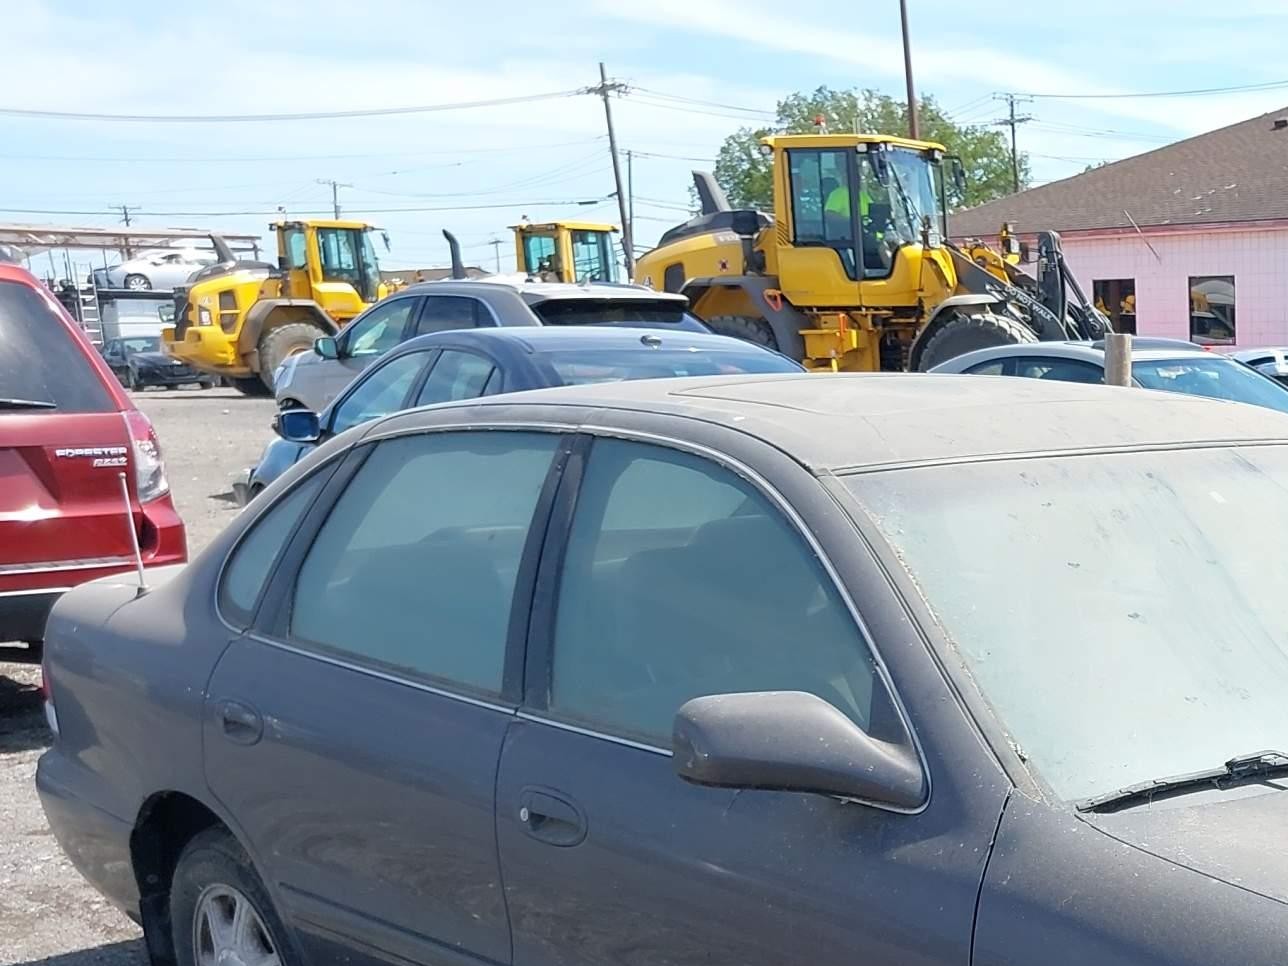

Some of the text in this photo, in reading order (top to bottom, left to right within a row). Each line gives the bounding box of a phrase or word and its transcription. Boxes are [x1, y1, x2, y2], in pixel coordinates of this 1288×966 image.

[1016, 293, 1033, 306] NOT
[1032, 304, 1053, 321] WALK
[55, 446, 128, 457] FORESTER
